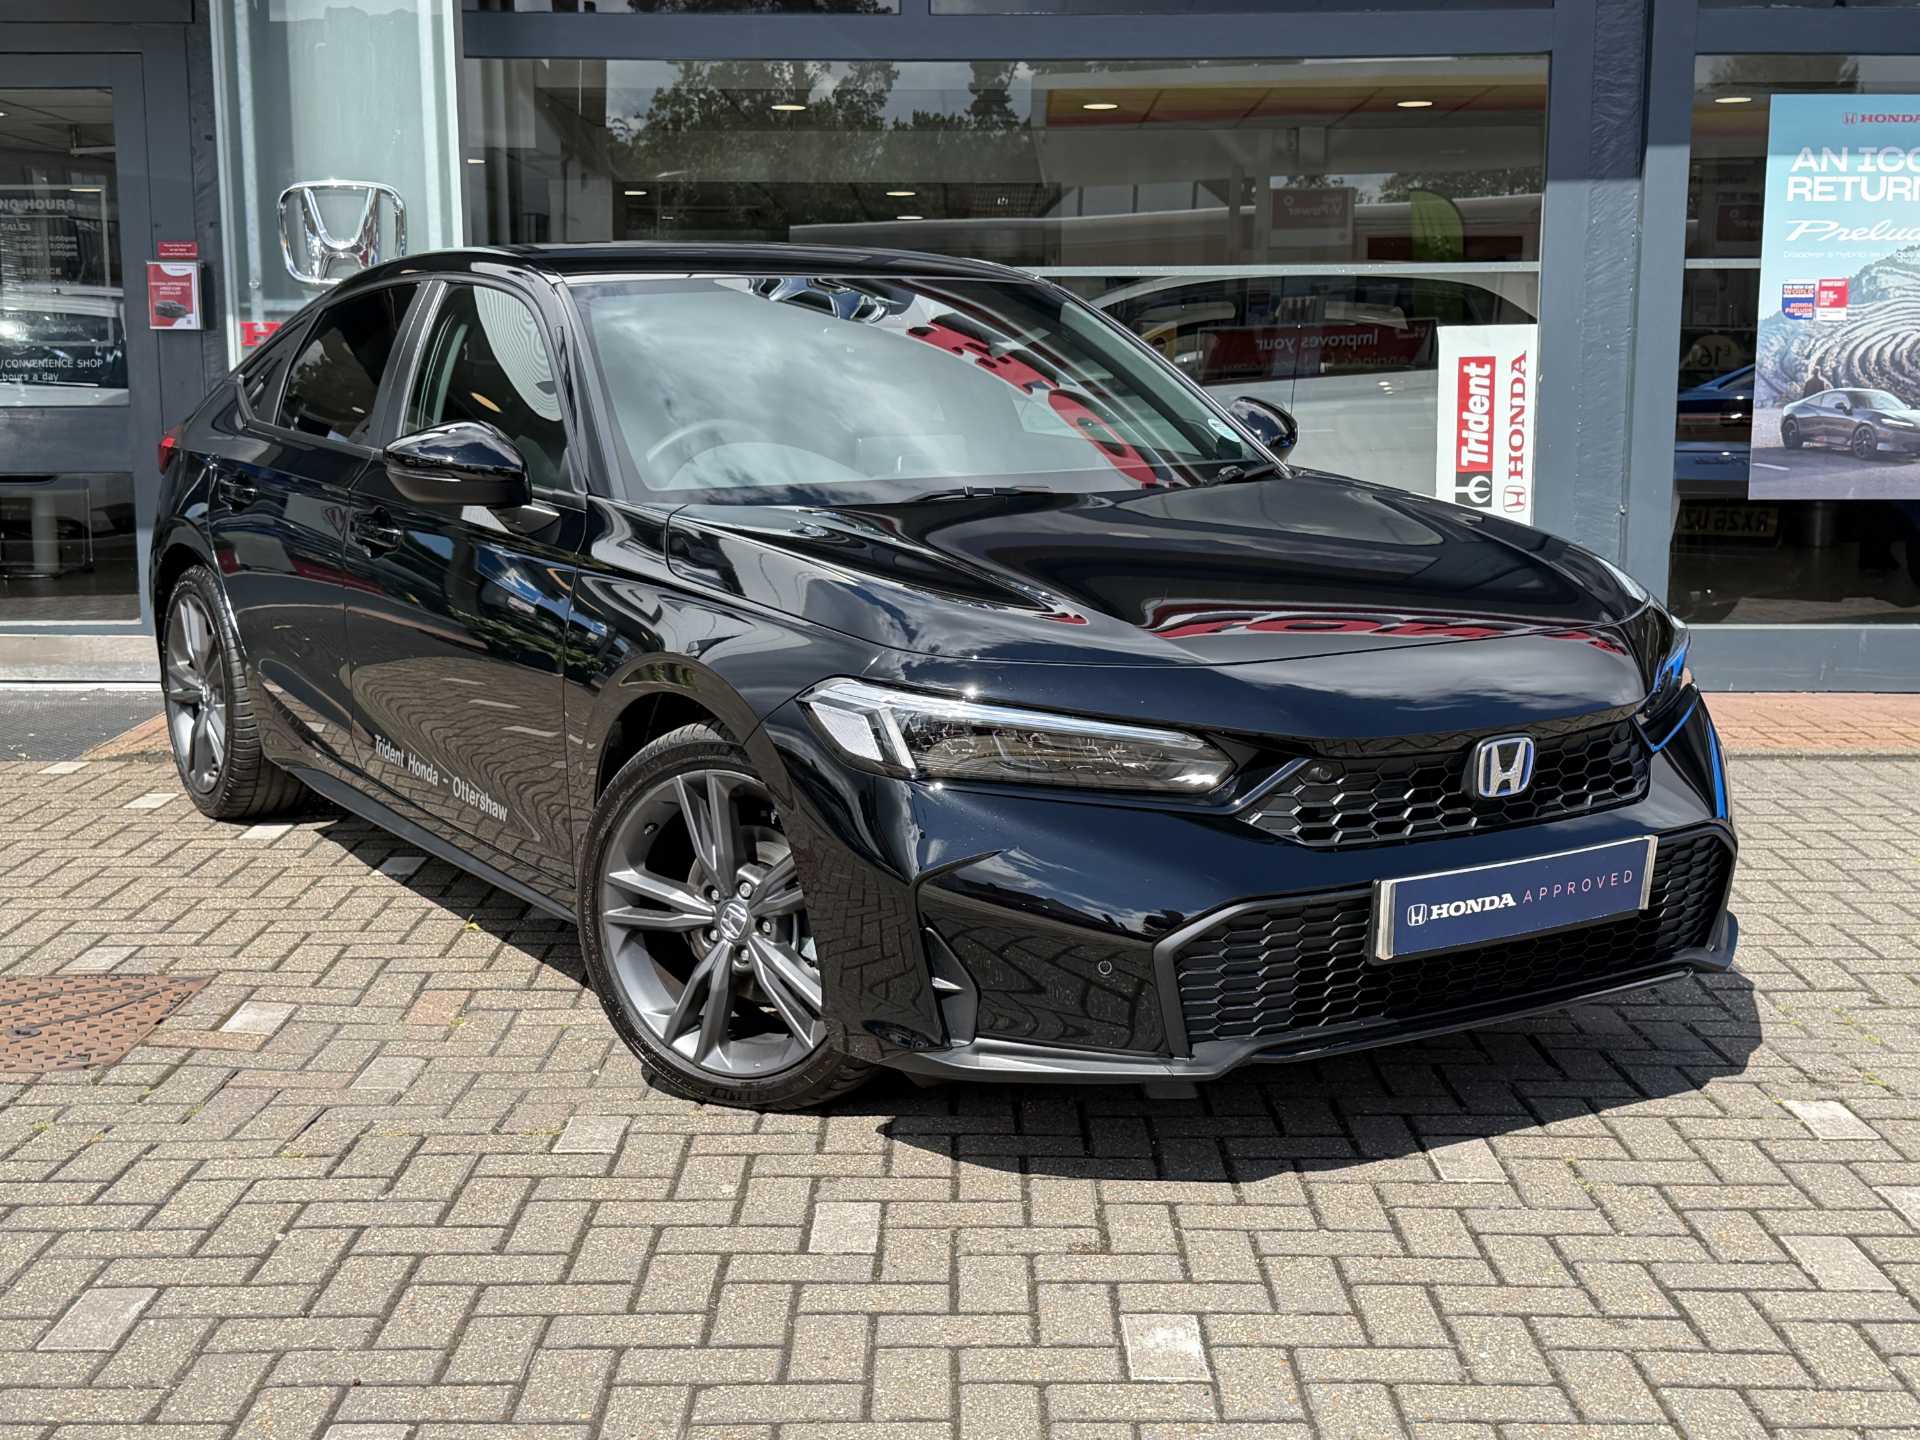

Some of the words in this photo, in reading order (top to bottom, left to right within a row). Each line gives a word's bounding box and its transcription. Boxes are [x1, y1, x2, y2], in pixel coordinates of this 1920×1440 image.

[1790, 147, 1848, 172] AN
[25, 198, 76, 210] HOURS
[42, 371, 59, 382] day
[77, 359, 103, 368] SHOP
[1460, 361, 1492, 467] Trident
[1508, 350, 1527, 480] HONDA
[374, 734, 405, 768] Trident
[407, 752, 439, 787] Honda
[452, 776, 509, 822] Ottershaw
[1430, 893, 1516, 920] HONDA
[1522, 869, 1633, 904] APPROVED
